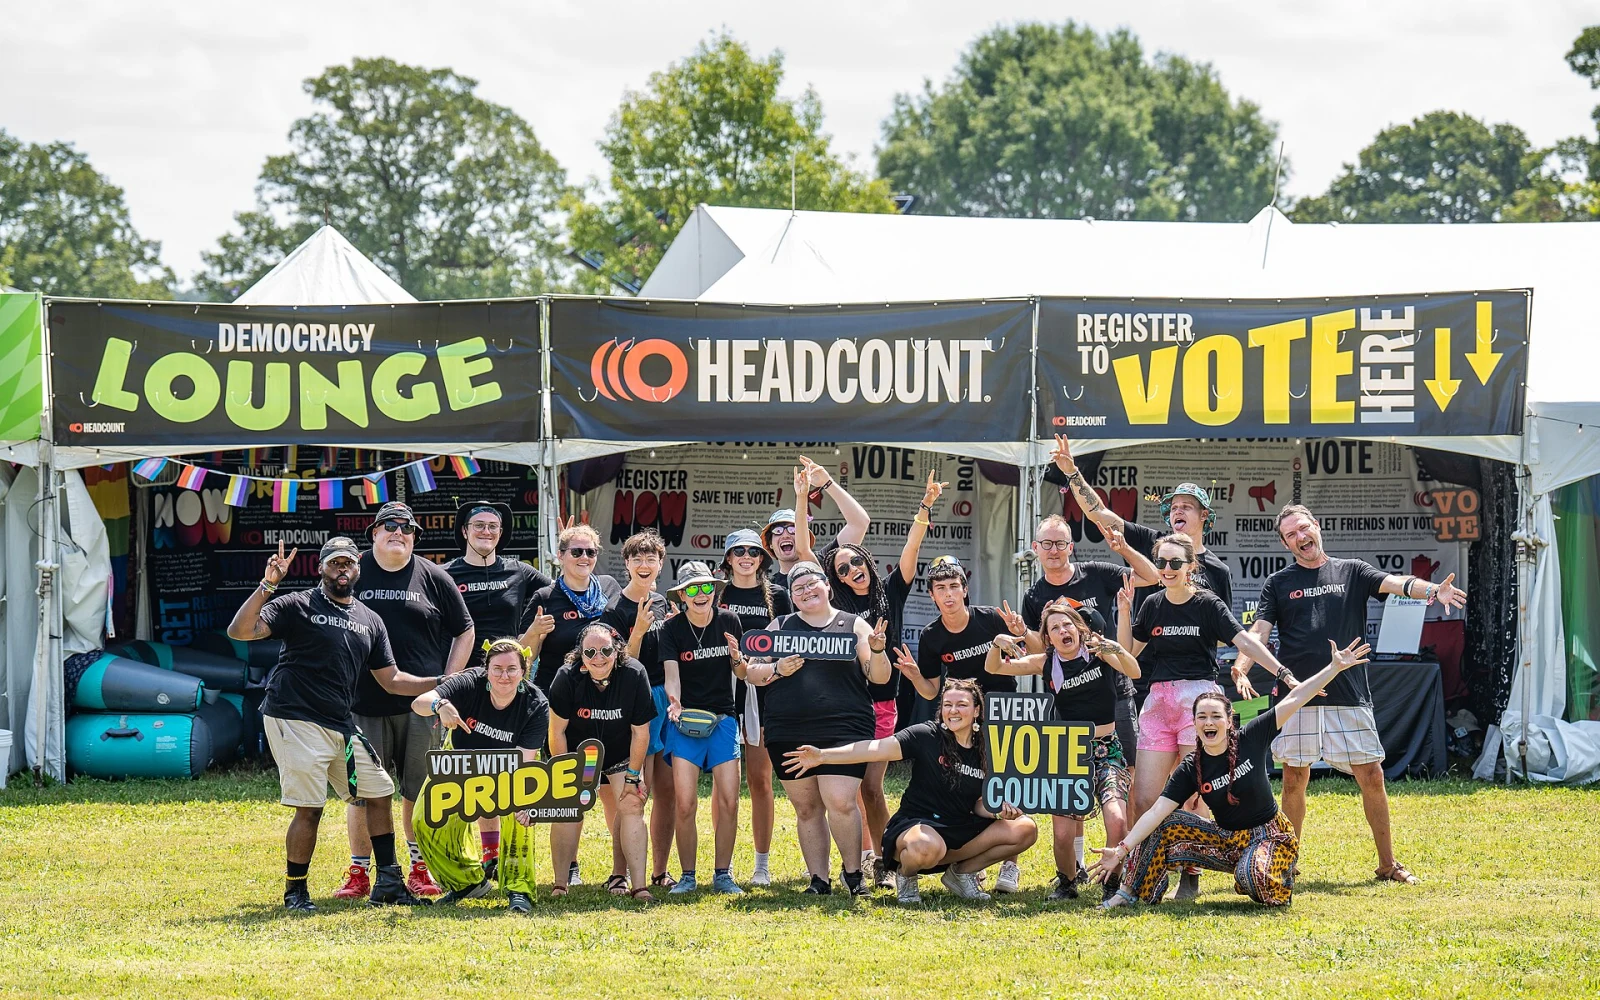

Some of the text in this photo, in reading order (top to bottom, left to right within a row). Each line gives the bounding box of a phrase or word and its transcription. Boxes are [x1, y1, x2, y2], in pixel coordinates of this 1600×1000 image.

[218, 322, 375, 353] DEMOCRACY
[1077, 312, 1193, 342] REGISTER
[697, 339, 986, 403] HEADCOUNT
[1080, 345, 1109, 375] TO
[1112, 308, 1356, 426] VOTE
[1359, 305, 1415, 424] HERE
[91, 335, 503, 431] LOUNGE
[83, 422, 126, 433] HEADCOUNT
[1066, 415, 1107, 426] HEADCOUNT
[852, 445, 916, 481] VOTE
[1305, 440, 1373, 475] VOTE
[616, 468, 689, 490] REGISTER
[692, 490, 721, 504] SAVE
[723, 491, 744, 505] THE
[154, 488, 233, 536] NOW
[425, 515, 446, 530] LET
[613, 490, 689, 535] NOW
[1340, 516, 1385, 531] FRIENDS
[1388, 516, 1410, 531] NOT
[1412, 516, 1433, 530] VOT
[264, 529, 331, 546] HEADCOUNT
[954, 525, 973, 540] VOTE
[374, 589, 421, 603] HEADCOUNT
[1303, 583, 1346, 598] HEADCOUNT
[159, 598, 194, 646] GET
[1162, 625, 1201, 637] HEADCOUNT
[774, 635, 853, 656] HEADCOUNT
[1062, 666, 1102, 690] HEADCOUNT
[989, 697, 1049, 721] EVERY
[475, 721, 514, 743] HEADCOUNT
[988, 724, 1090, 775] VOTE
[430, 753, 519, 775] VOTE WITH
[1212, 758, 1254, 791] HEADCOUNT
[986, 776, 1090, 811] COUNTS
[538, 807, 579, 818] HEADCOUNT
